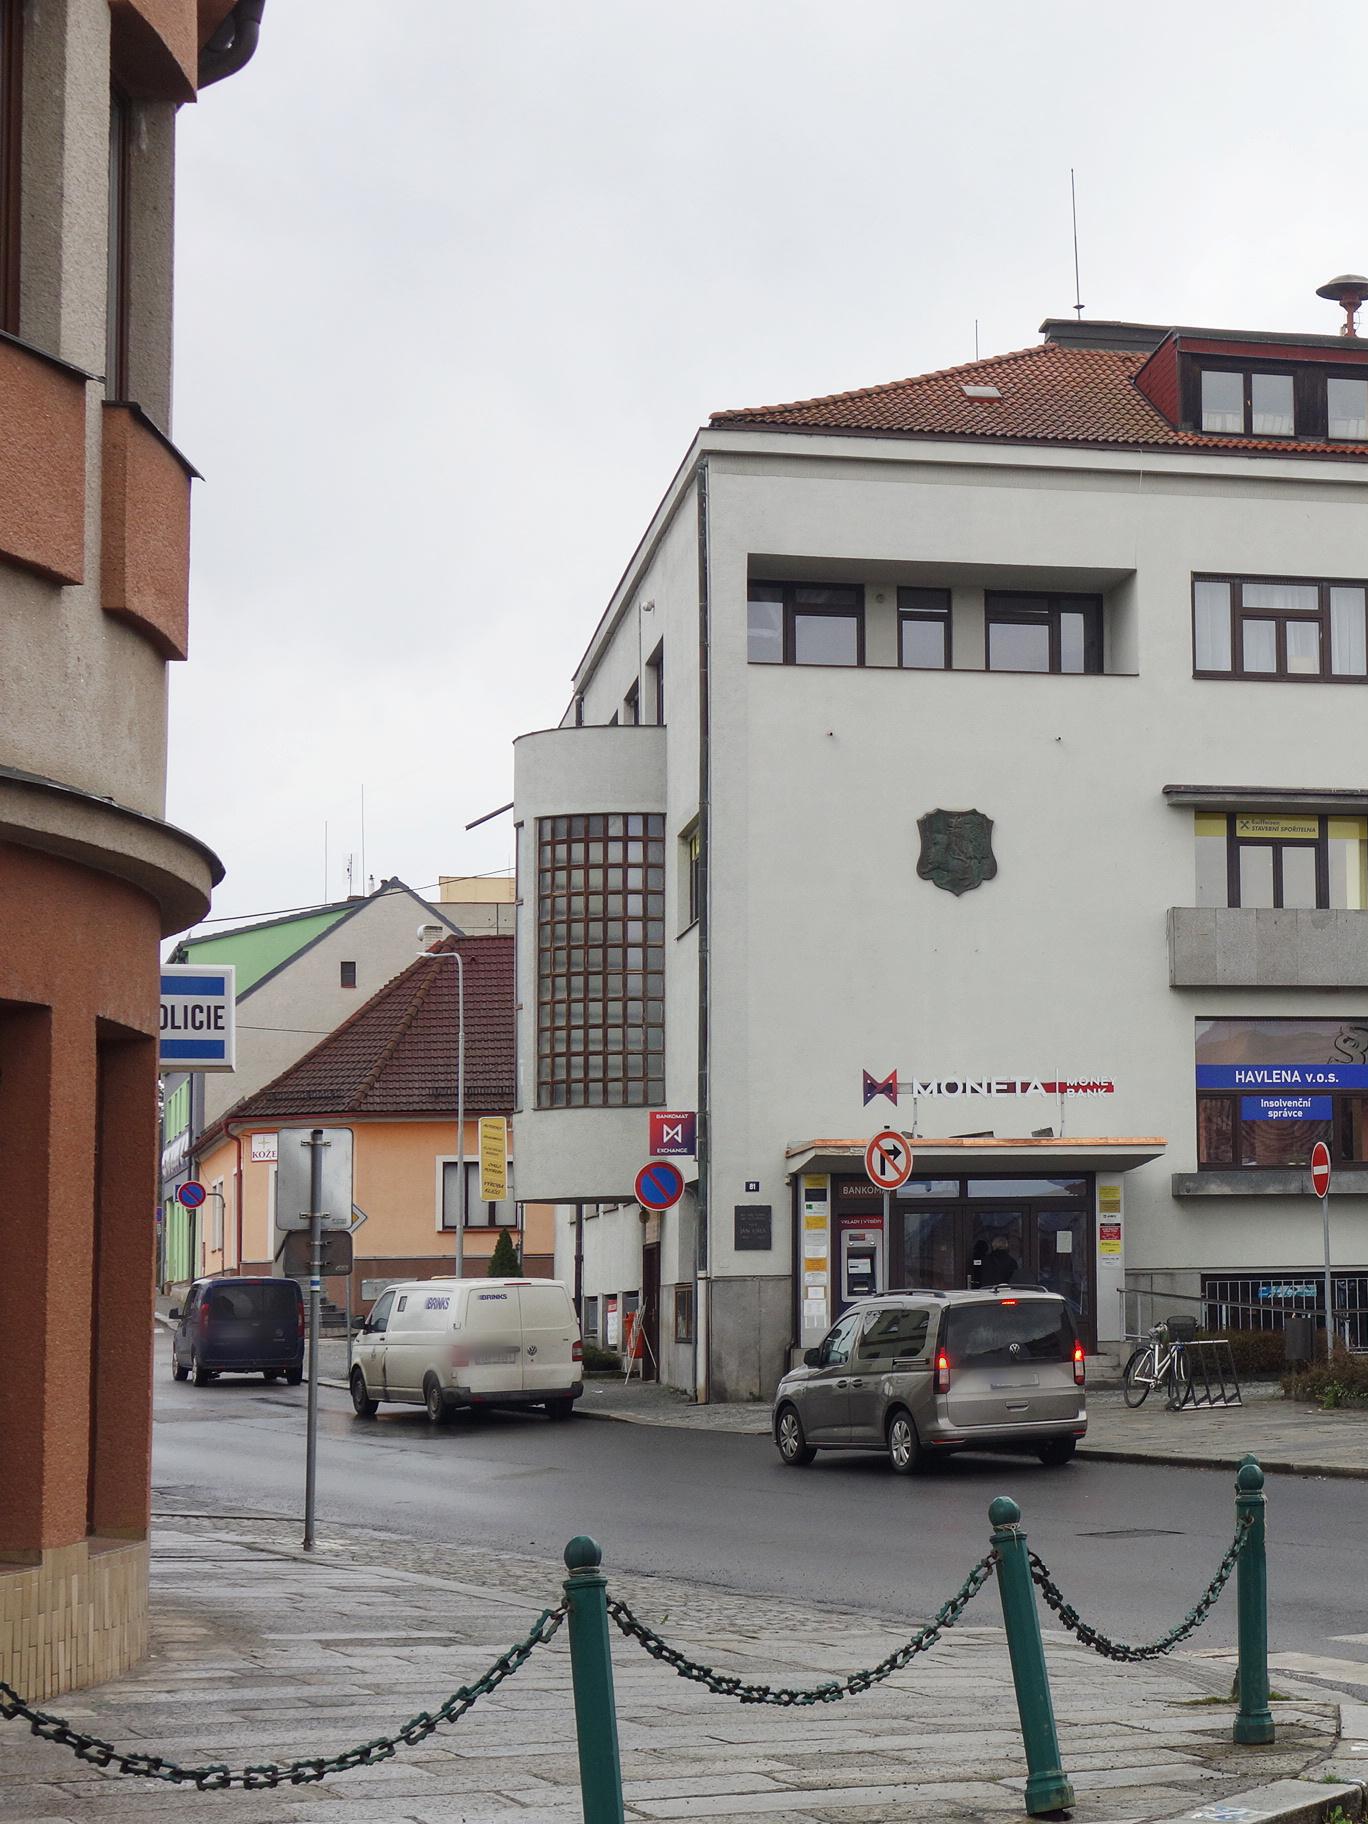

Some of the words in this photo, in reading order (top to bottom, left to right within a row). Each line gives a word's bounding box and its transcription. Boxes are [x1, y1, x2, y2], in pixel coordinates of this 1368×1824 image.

[1251, 824, 1279, 832] STAVEBNÍ
[160, 1004, 225, 1030] OLICIE
[1066, 1076, 1115, 1087] MONEY
[1235, 1070, 1301, 1083] HAVLENA
[1305, 1073, 1339, 1083] v.o.s.
[912, 1077, 1048, 1099] MONETA
[1068, 1088, 1108, 1098] BANK
[1260, 1098, 1311, 1108] Insolvenční
[1267, 1109, 1303, 1119] správce
[842, 1186, 889, 1195] BANKOM
